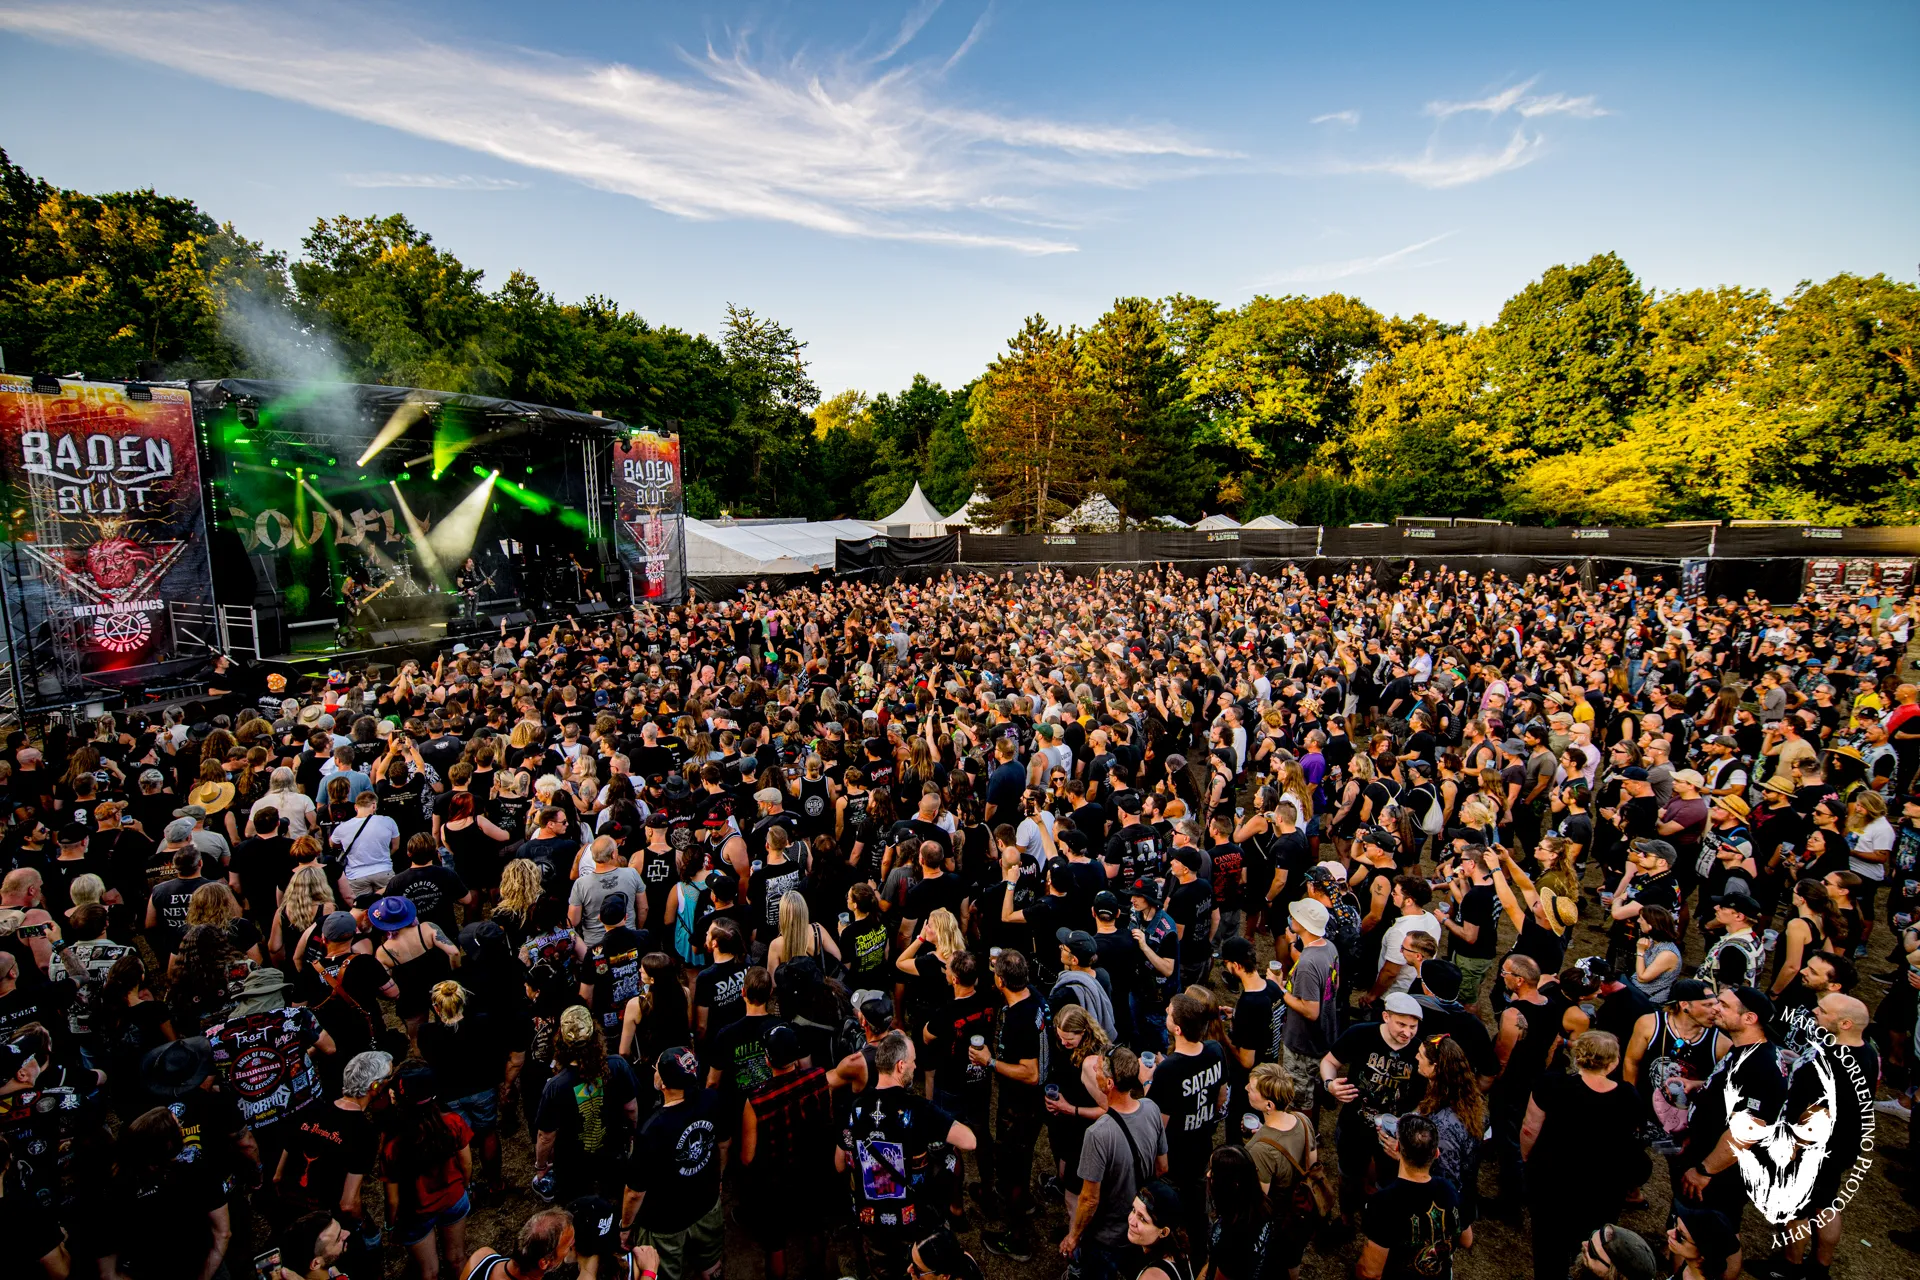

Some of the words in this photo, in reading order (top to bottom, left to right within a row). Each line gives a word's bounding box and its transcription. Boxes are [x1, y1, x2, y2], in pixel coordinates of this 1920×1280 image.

[21, 431, 173, 478] BADEN
[97, 473, 108, 483] IN
[624, 459, 674, 482] BADEN
[57, 485, 152, 514] BLUT
[636, 489, 667, 505] BLUT
[73, 604, 110, 617] METAL
[112, 599, 165, 614] MANIACS
[1213, 852, 1244, 867] CANNIBAL
[230, 1025, 274, 1049] FROST
[235, 1062, 280, 1079] Hanneman
[1182, 1060, 1221, 1097] SATAN
[1371, 1072, 1398, 1088] BLUT
[1196, 1088, 1207, 1109] IS
[1184, 1103, 1214, 1131] REAL
[181, 1123, 200, 1137] ront
